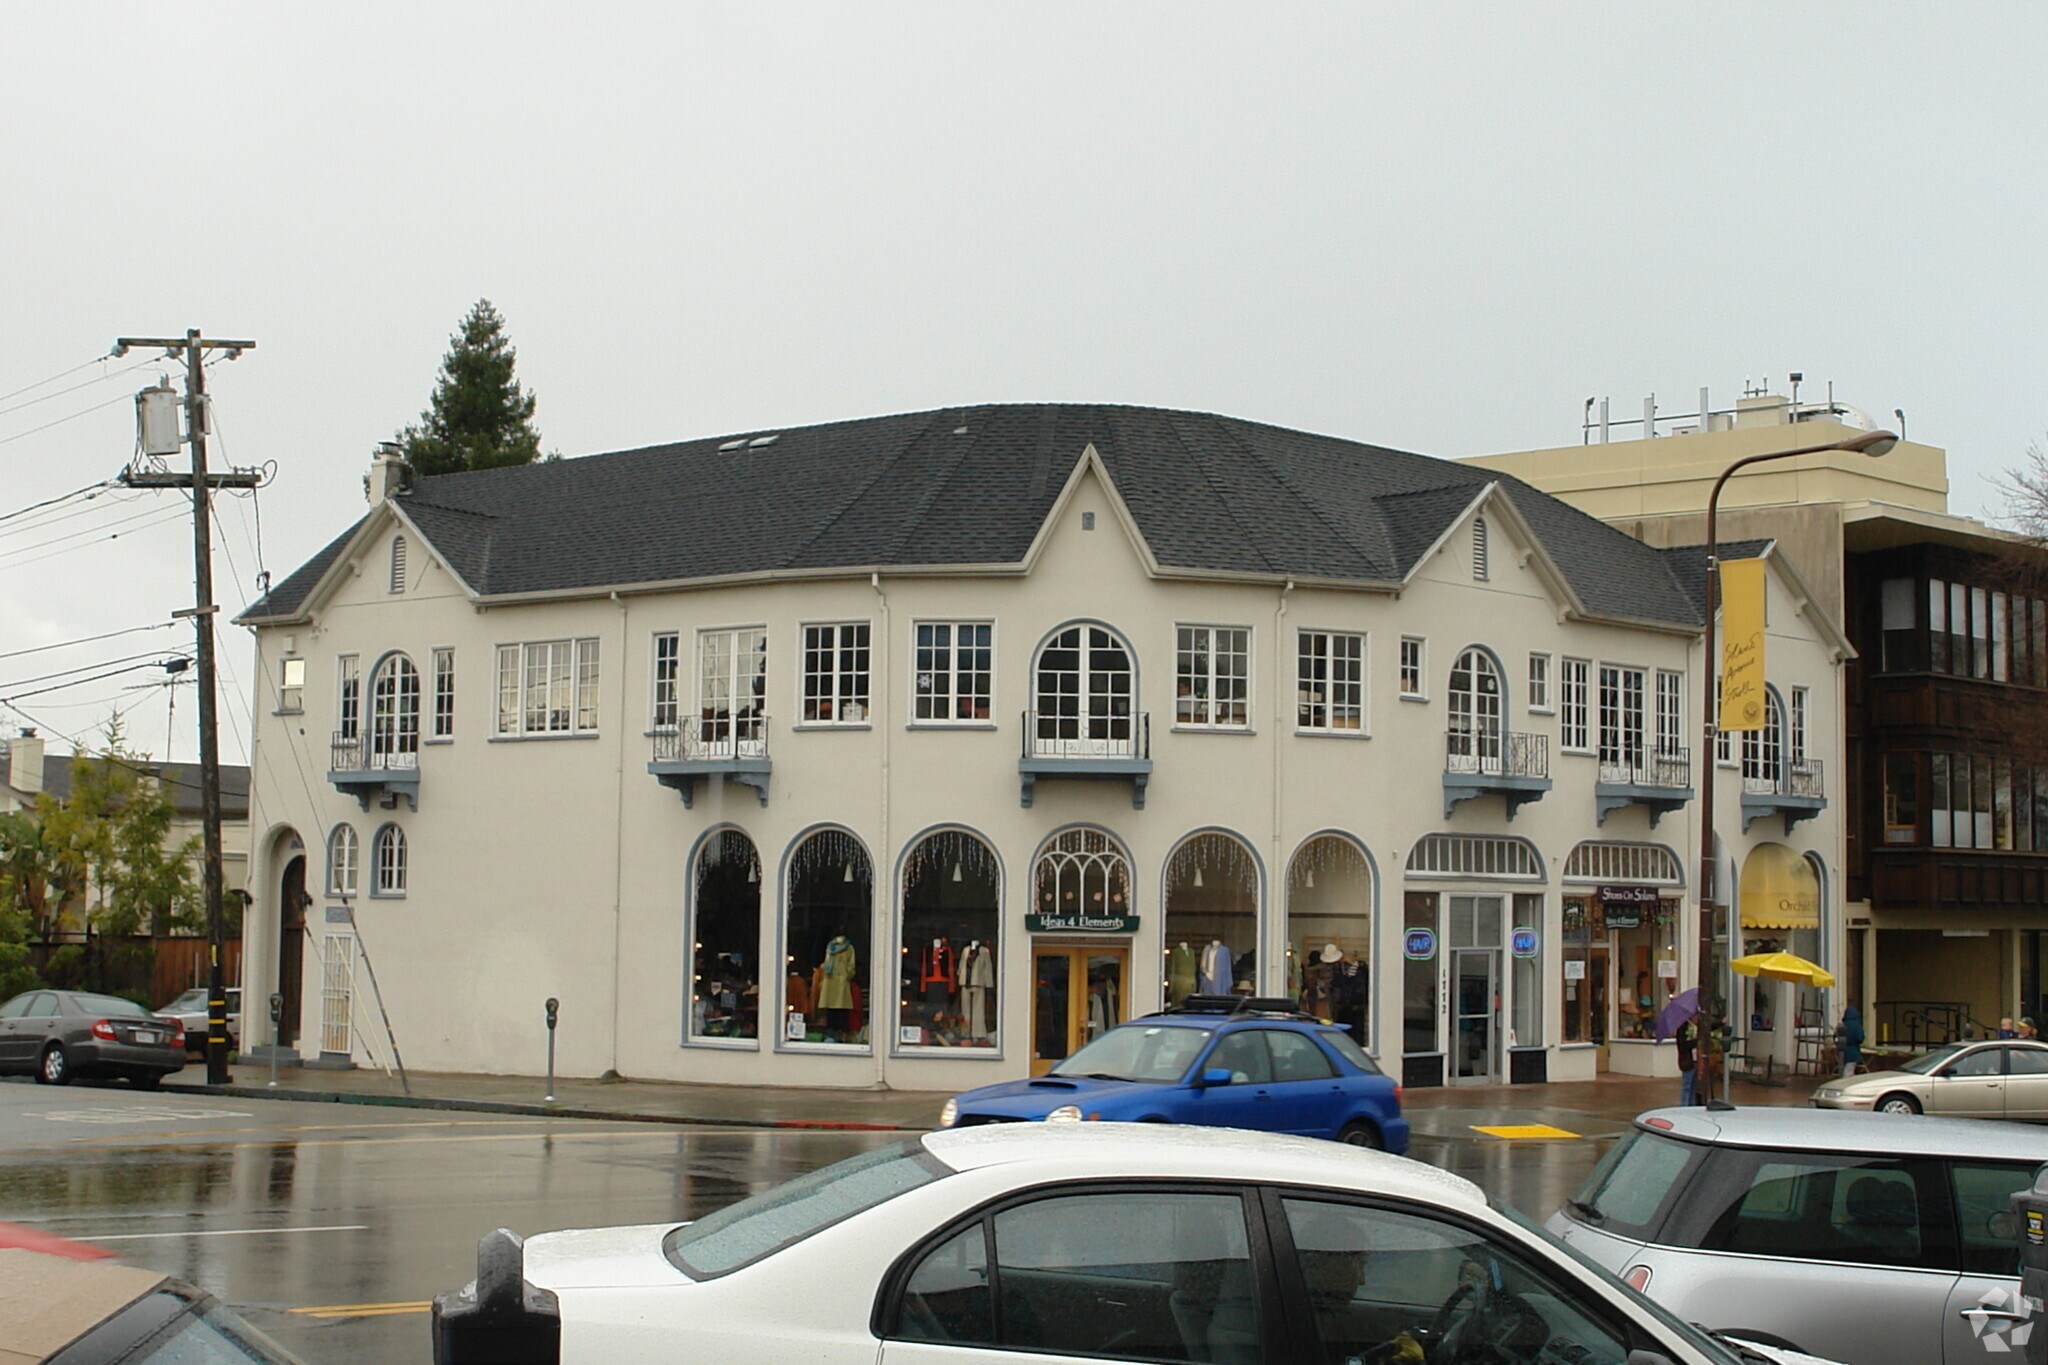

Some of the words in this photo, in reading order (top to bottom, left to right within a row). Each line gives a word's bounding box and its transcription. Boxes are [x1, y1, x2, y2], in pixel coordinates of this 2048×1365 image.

[1040, 914, 1066, 927] Ideas
[1067, 916, 1075, 927] 4
[1079, 916, 1124, 928] Elements
